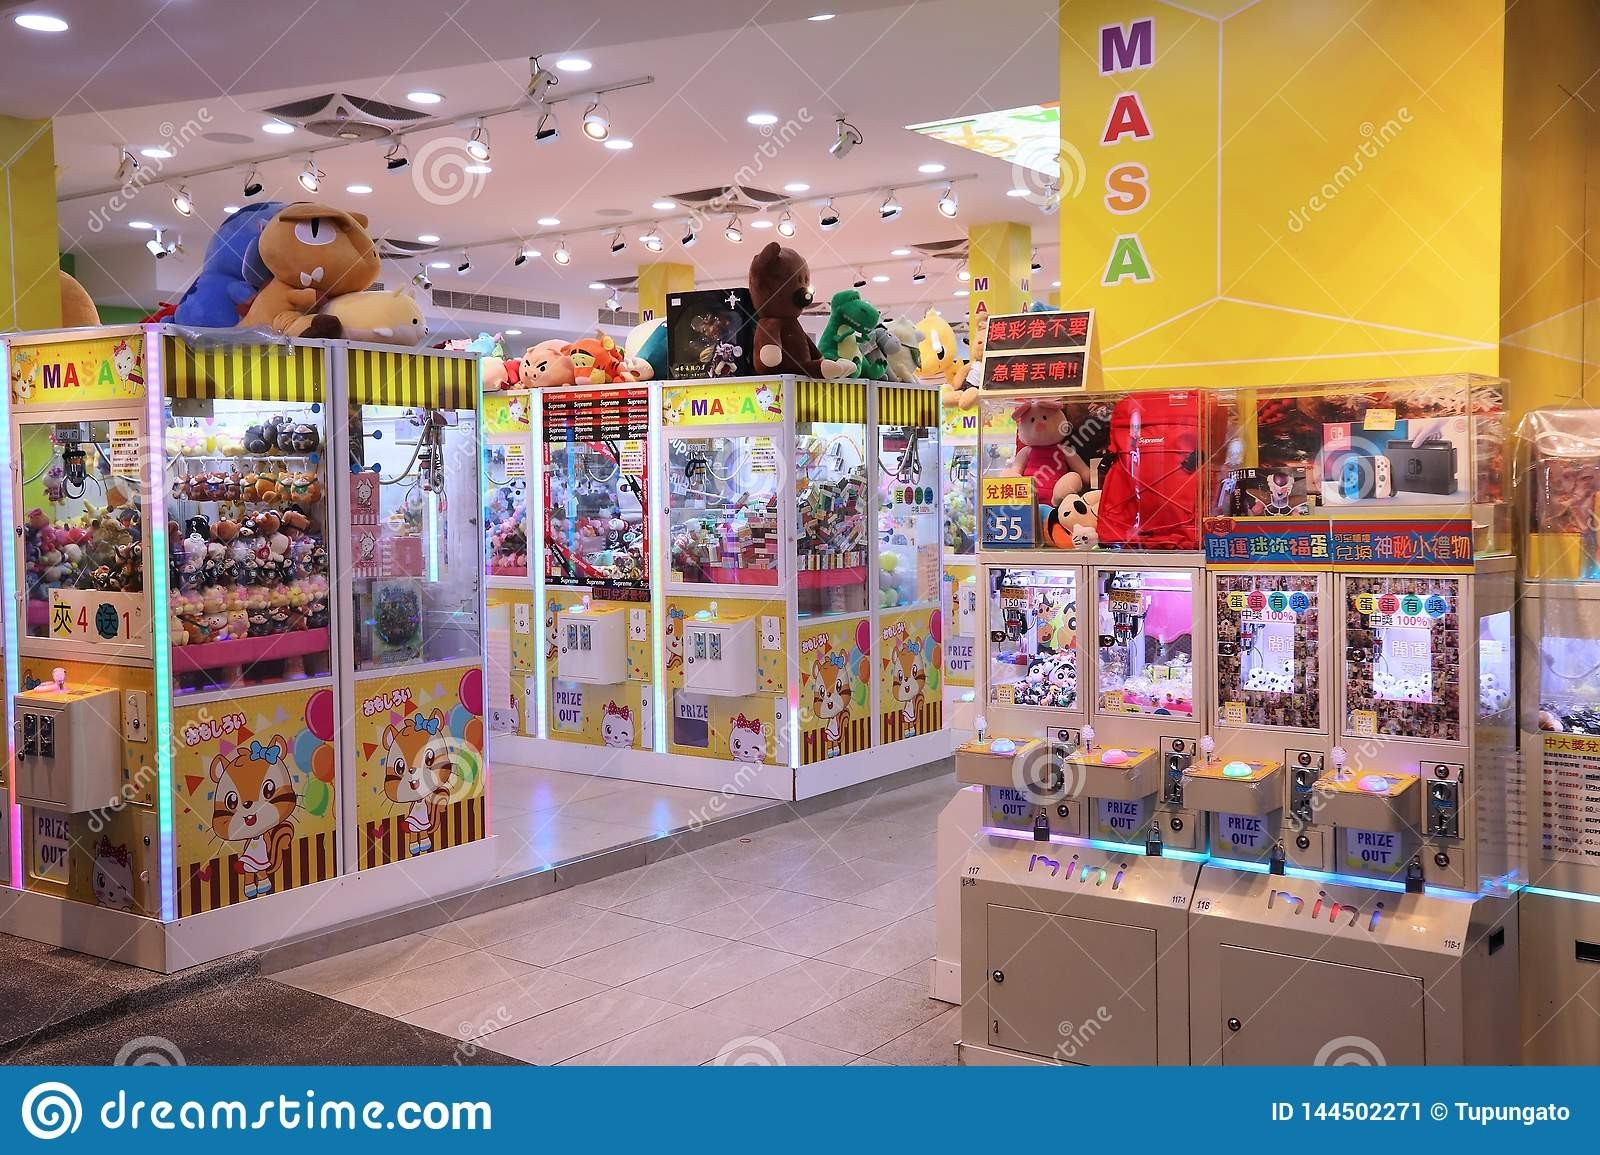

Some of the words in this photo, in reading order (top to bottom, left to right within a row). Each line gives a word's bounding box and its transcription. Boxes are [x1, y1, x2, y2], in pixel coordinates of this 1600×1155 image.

[1101, 19, 1154, 285] MASA
[43, 360, 115, 389] MASA
[691, 397, 756, 416] MASA
[987, 484, 1028, 499] 兌換區
[995, 516, 1022, 541] 55
[1208, 534, 1329, 558] 開運迷你福蛋
[560, 577, 579, 585] Supreme
[586, 578, 606, 586] Supreme
[1004, 598, 1018, 607] 150
[1112, 601, 1128, 610] 250
[1266, 610, 1293, 621] 100%
[1397, 615, 1428, 626] 100%
[949, 644, 972, 657] PRIZE
[950, 659, 971, 671] OUT
[363, 688, 412, 717] おもしろい
[557, 692, 582, 706] PRIZE
[559, 709, 581, 723] OUT
[680, 704, 708, 719] PRIZE
[185, 712, 247, 746] おもしろい
[1544, 737, 1599, 753] 中大獎兌
[1003, 804, 1026, 816] OUT
[1107, 801, 1137, 815] PRIZE
[39, 817, 69, 841] PRIZE
[1110, 817, 1135, 830] OUT
[1228, 816, 1261, 831] PRIZE
[1232, 833, 1258, 847] OUT
[1358, 832, 1394, 848] PRIZE
[42, 845, 67, 867] OUT
[1361, 849, 1391, 864] OUT
[968, 866, 980, 875] 117
[1028, 854, 1127, 890] mini
[1196, 899, 1210, 910] 118
[1268, 889, 1384, 932] mini
